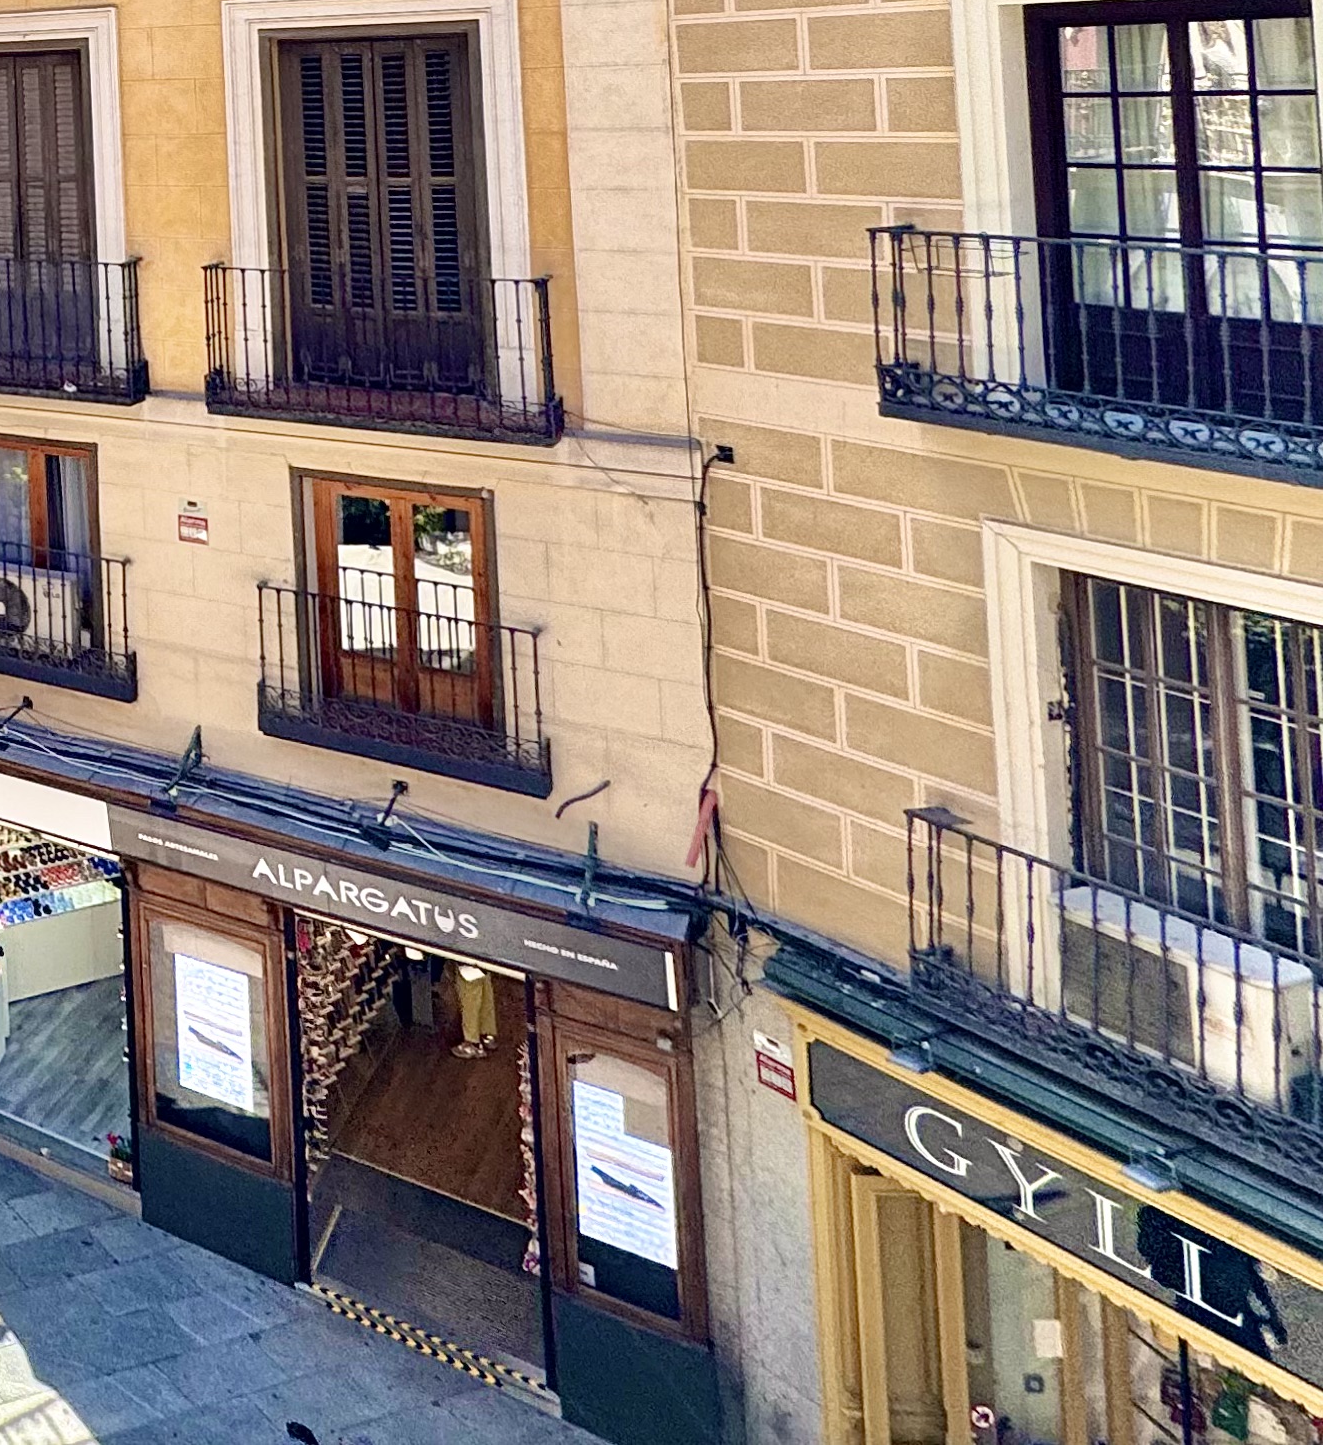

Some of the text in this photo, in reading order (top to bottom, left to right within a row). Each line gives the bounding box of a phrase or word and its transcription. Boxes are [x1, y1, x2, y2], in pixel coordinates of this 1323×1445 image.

[252, 858, 479, 939] ALPARGATUS
[523, 939, 619, 970] HECHO EN ESPAÑA
[904, 1106, 1243, 1328] GYLL
